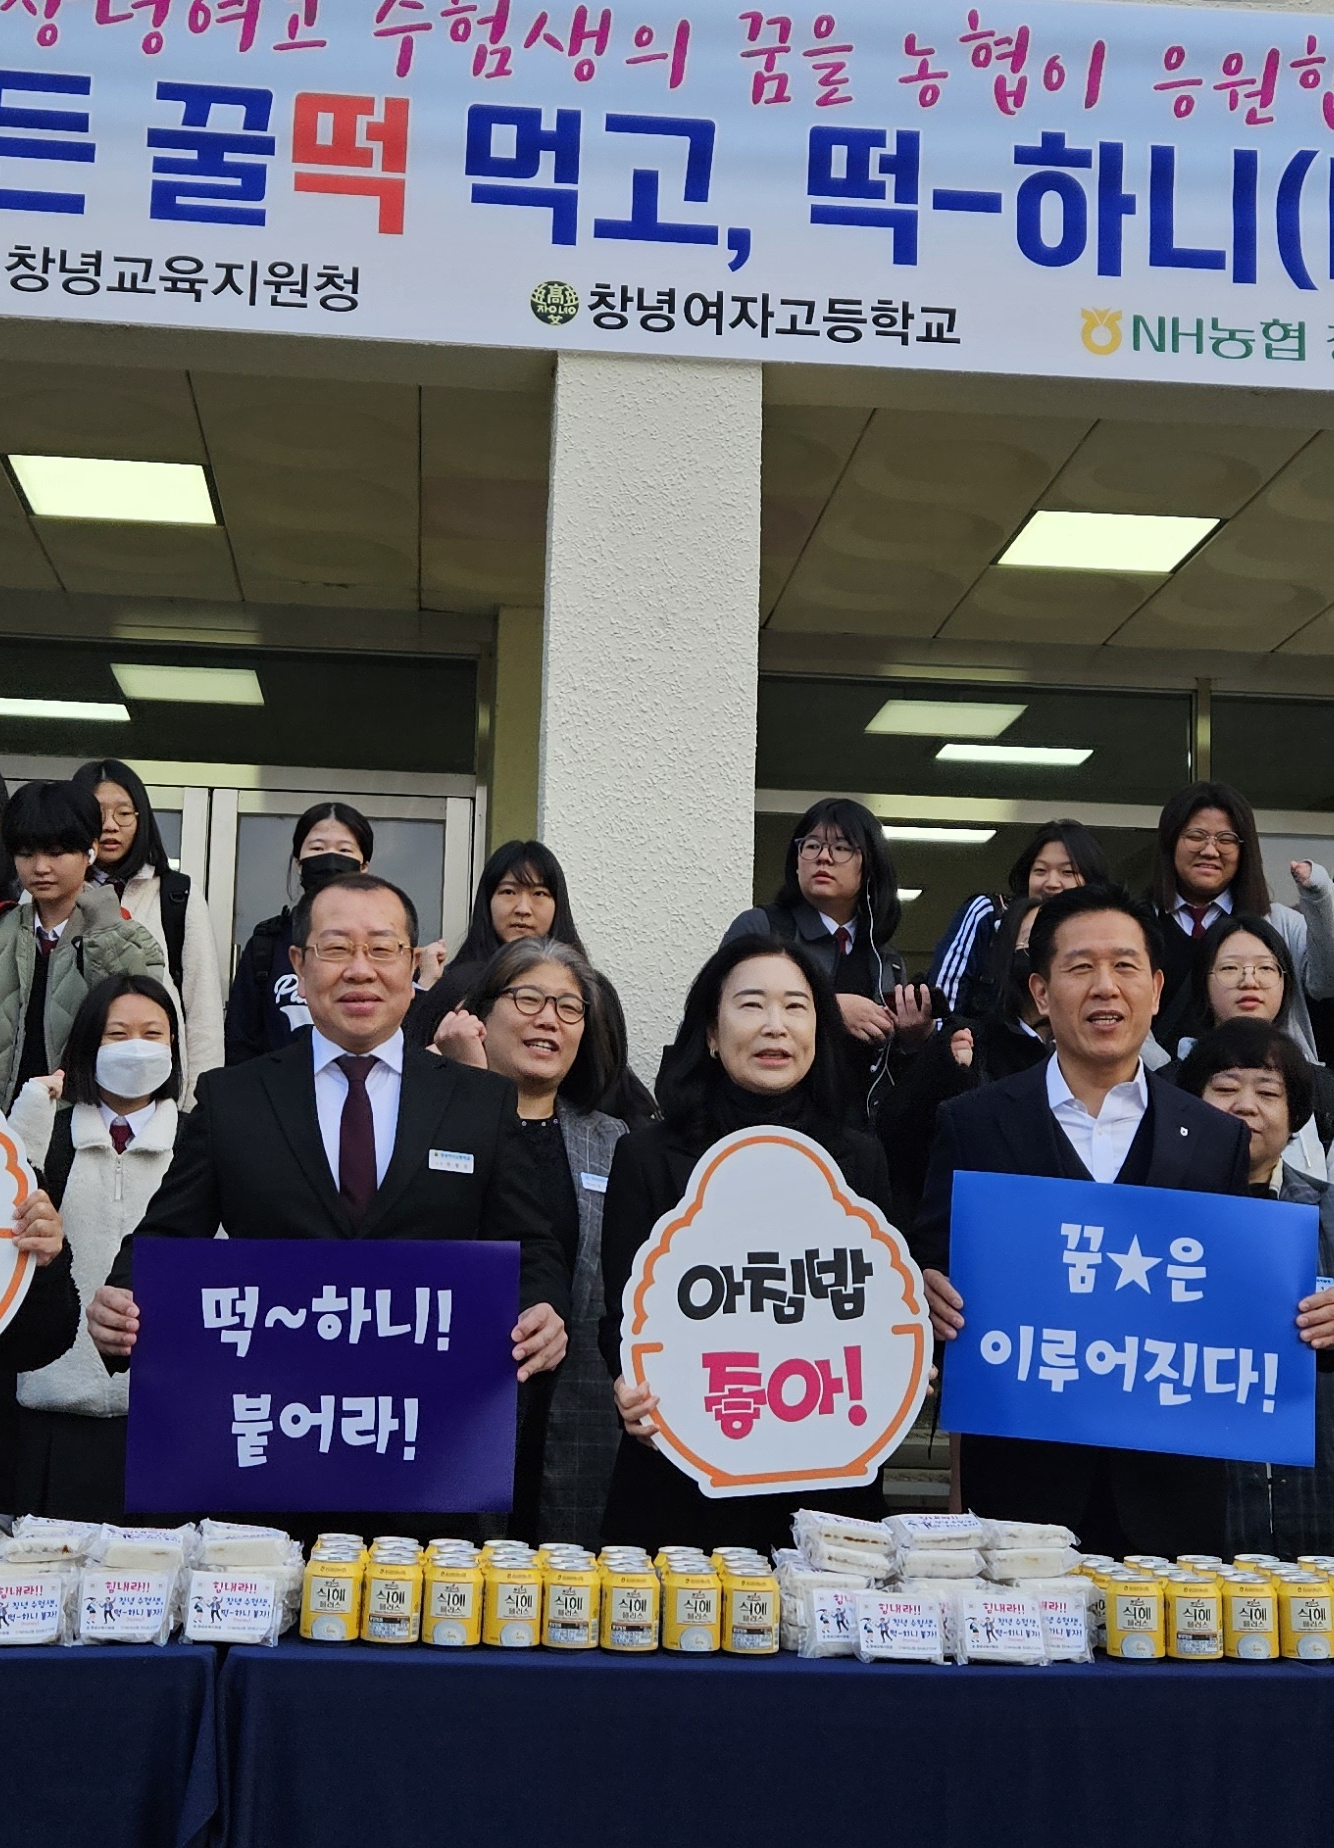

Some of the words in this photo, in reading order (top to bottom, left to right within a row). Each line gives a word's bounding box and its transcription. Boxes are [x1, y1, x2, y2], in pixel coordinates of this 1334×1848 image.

[739, 10, 855, 108] 꿈을
[898, 9, 1106, 116] 농협이
[147, 81, 409, 235] 꿀떡
[466, 103, 752, 272] 먹고,
[5, 244, 360, 312] 창녕교육지원청
[587, 283, 961, 346] 창녕여자고등학교
[1132, 313, 1307, 362] NH농협
[201, 1285, 452, 1357] 떡~하니!
[677, 1248, 873, 1324] 아침밥
[702, 1345, 867, 1439] 좋아!
[980, 1325, 1278, 1413] 이루어진다!
[231, 1394, 418, 1467] 붙어라!
